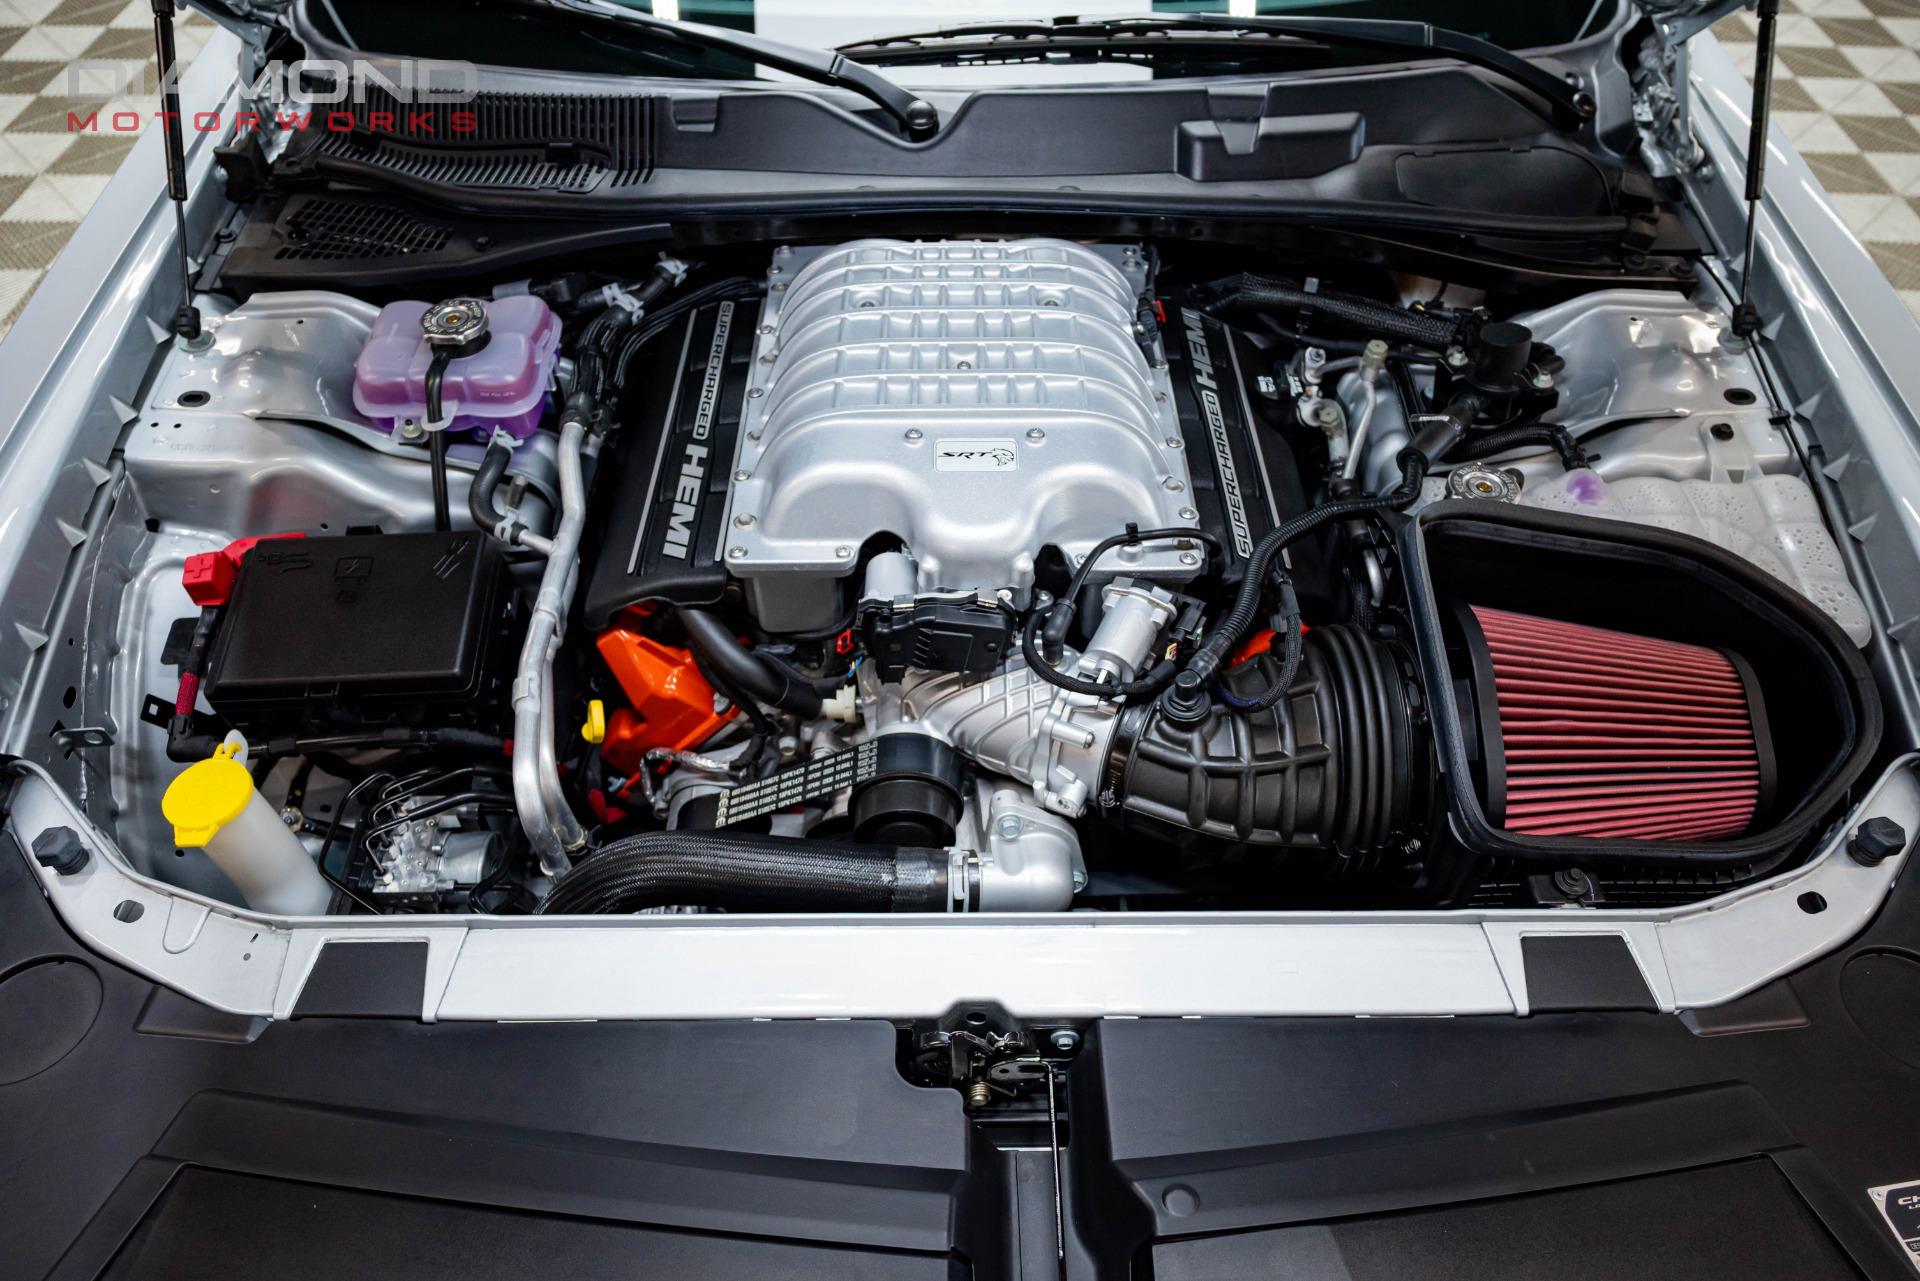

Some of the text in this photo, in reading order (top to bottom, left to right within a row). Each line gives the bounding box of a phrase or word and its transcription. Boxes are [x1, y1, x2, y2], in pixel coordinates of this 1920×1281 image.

[662, 303, 733, 560] SUPERCHARGED HEMI
[1181, 307, 1250, 558] SUPERCHARGED HEMI
